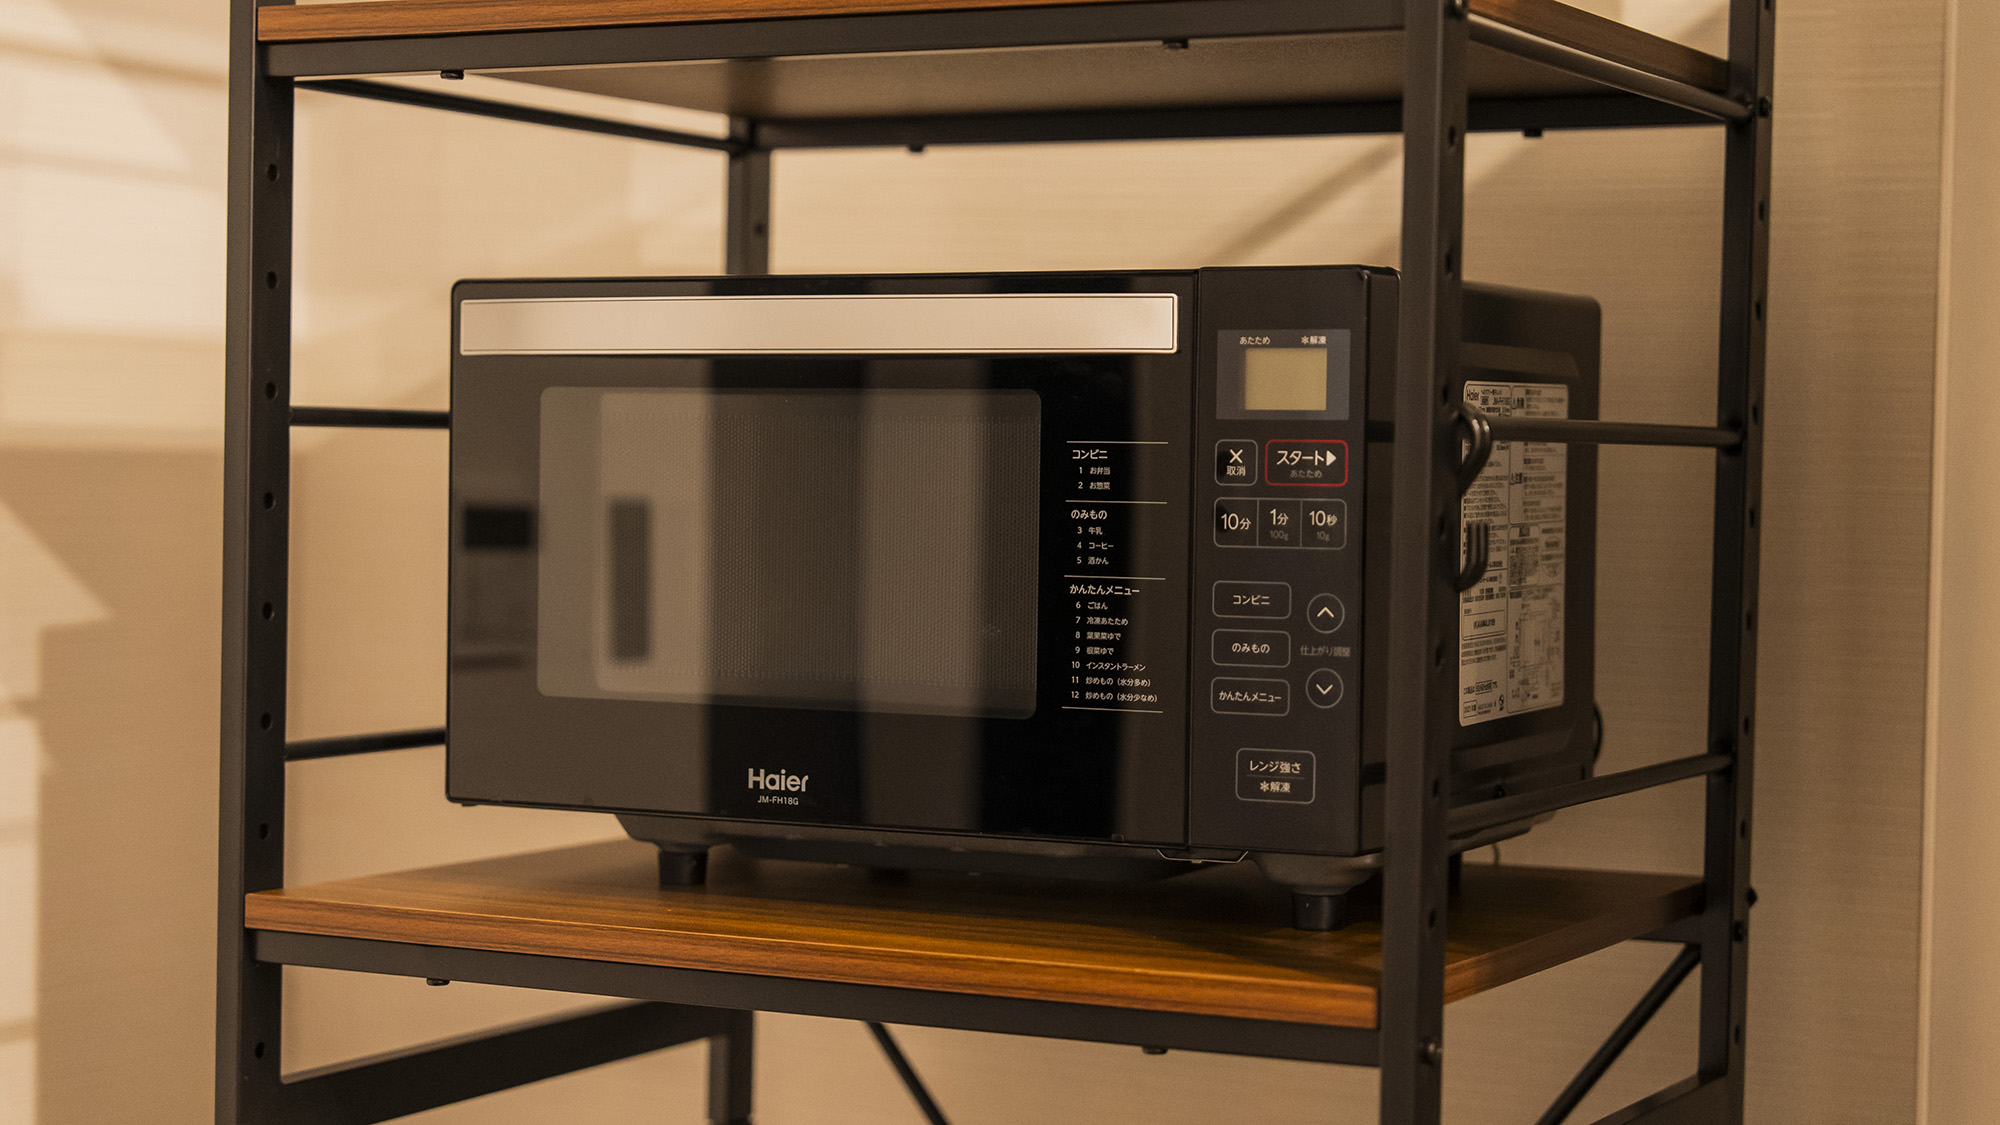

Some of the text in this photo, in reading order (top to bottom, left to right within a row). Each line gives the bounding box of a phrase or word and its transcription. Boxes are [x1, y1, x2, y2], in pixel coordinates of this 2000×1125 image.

[1239, 336, 1271, 345] あたため
[1309, 335, 1327, 345] 解凍
[1467, 389, 1480, 401] Haier
[1072, 448, 1108, 460] コンビニ
[1276, 449, 1325, 466] スタート
[1079, 466, 1111, 475] 1 お弁当
[1226, 465, 1246, 477] 取消
[1289, 469, 1323, 479] あたため
[1077, 481, 1111, 490] 2 お惣菜
[1070, 509, 1108, 520] のみもの
[1269, 508, 1289, 526] 1分
[1309, 510, 1338, 527] 10秒
[1220, 512, 1252, 531] 10分
[1077, 526, 1104, 536] 3 牛乳
[1269, 529, 1289, 542] 100g
[1316, 530, 1330, 543] 10g
[1076, 541, 1114, 550] 4 コーヒー
[1076, 556, 1110, 565] 5 酒かん
[1069, 583, 1140, 596] かんたんメニュー
[1075, 601, 1109, 610] 6 ごはん
[1232, 594, 1271, 606] コンビニ
[1075, 615, 1129, 626] 7 冷凍あたため
[1075, 630, 1081, 639] 8
[1074, 645, 1115, 656] 9 根菜ゆで
[1231, 642, 1271, 654] のみもの
[1300, 645, 1351, 658] 仕上がり調整
[1071, 660, 1147, 672] 10 インスタントラーメン
[1071, 675, 1079, 684] 11
[1071, 690, 1080, 699] 12
[1218, 690, 1282, 703] かんたんメニュー
[1249, 760, 1301, 774] レンジ強さ
[748, 767, 809, 793] Haier
[1269, 781, 1291, 793] 解凍
[757, 795, 799, 806] JM-FH18G
